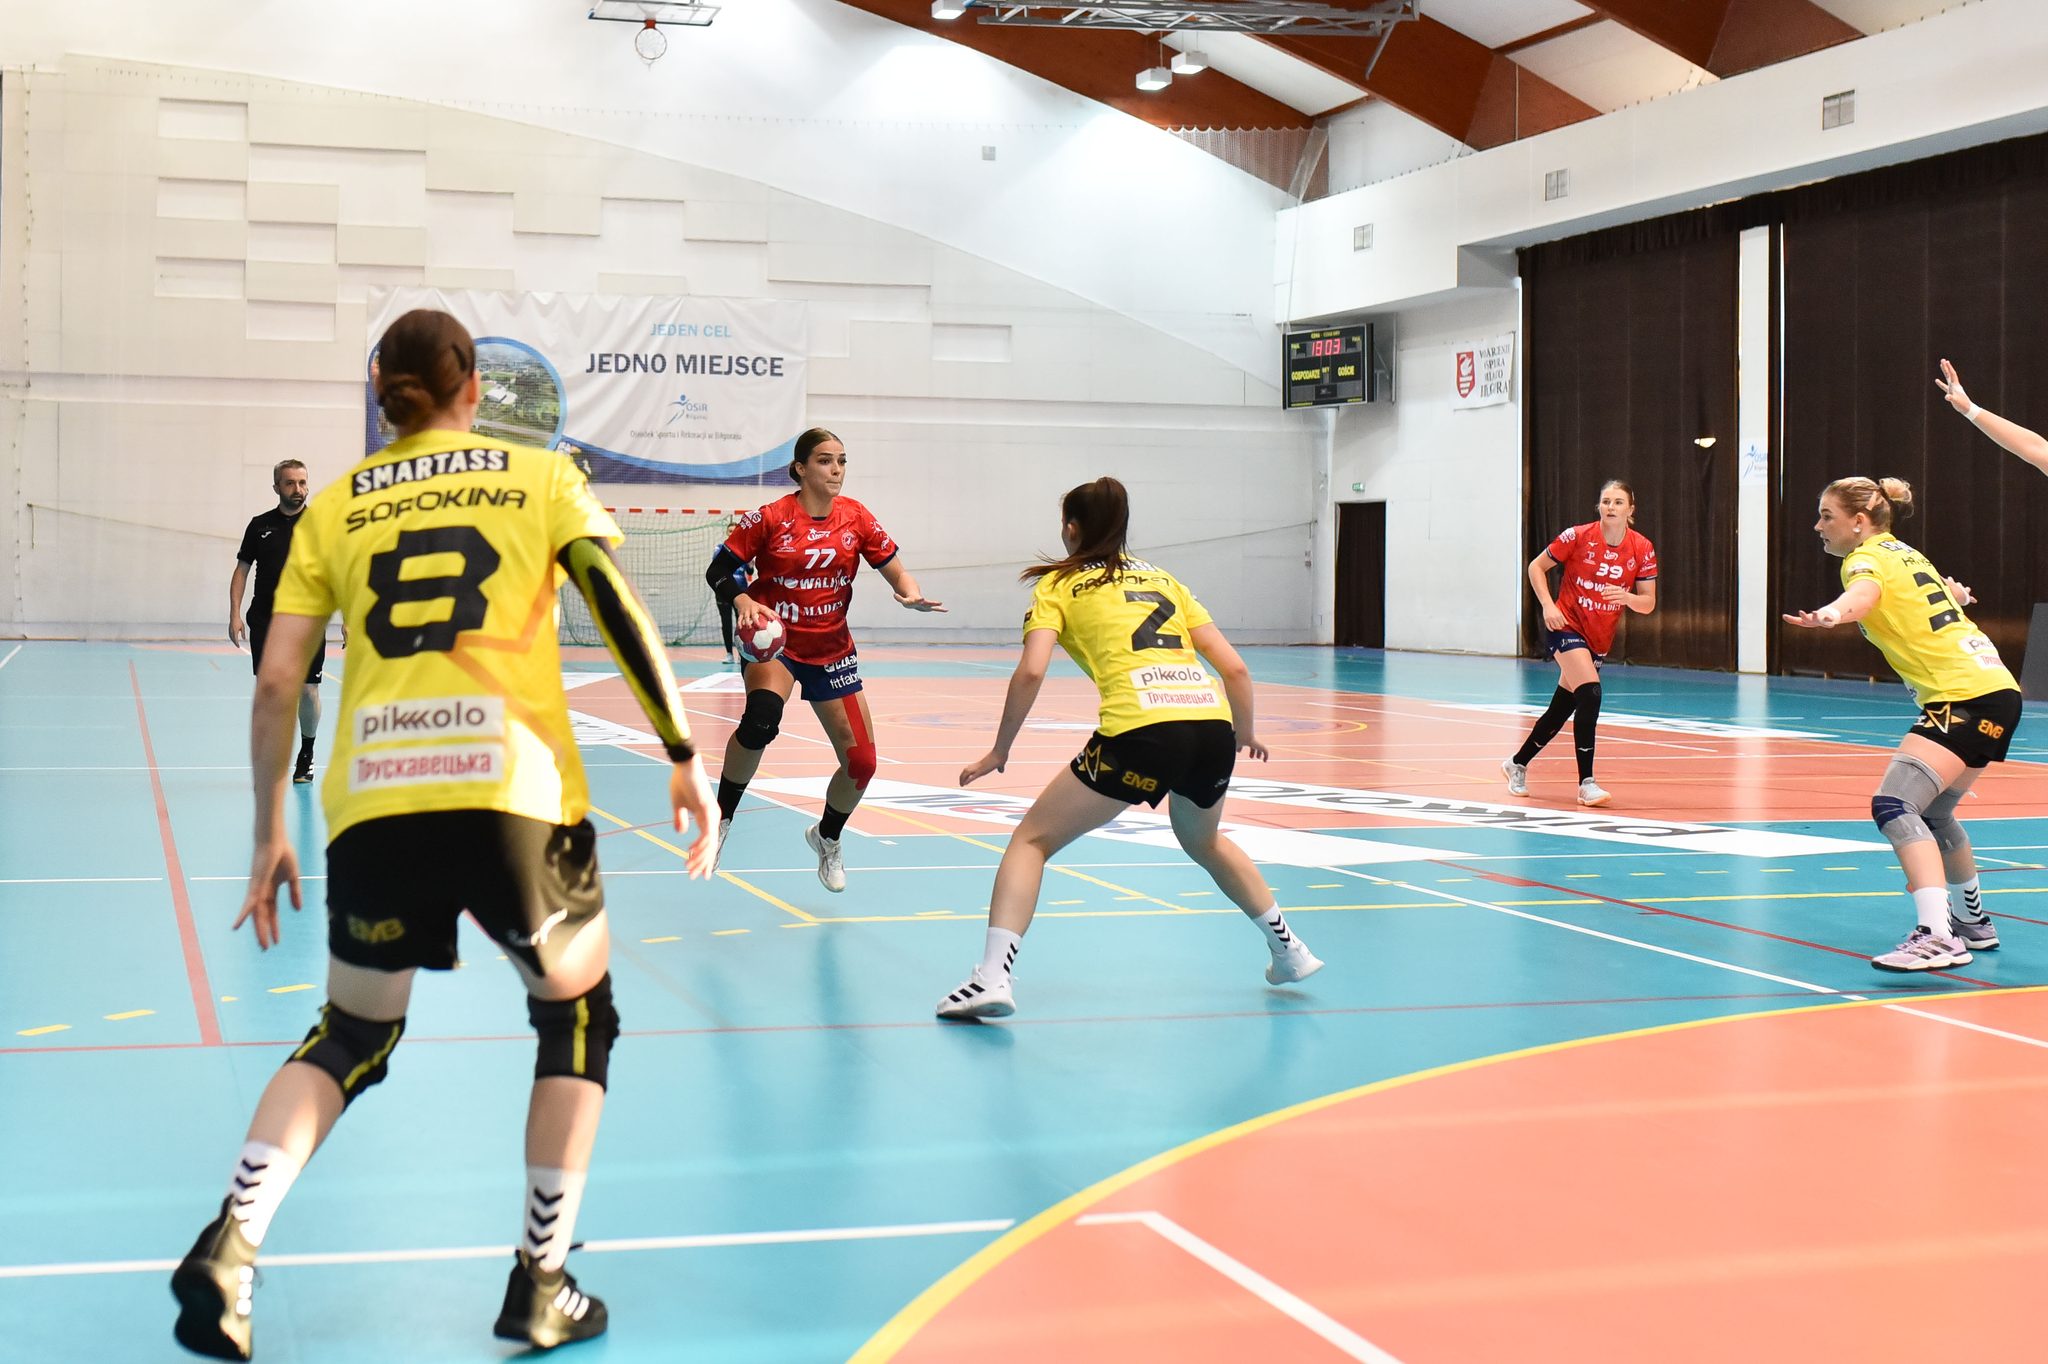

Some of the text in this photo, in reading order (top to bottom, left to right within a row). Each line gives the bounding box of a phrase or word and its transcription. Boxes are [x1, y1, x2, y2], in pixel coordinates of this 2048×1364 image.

[650, 322, 732, 338] JEDEN CEL
[585, 353, 785, 378] JEDNO MIEJSCE
[355, 448, 505, 494] SMARTASS
[804, 548, 837, 570] 77
[1595, 562, 1624, 580] 39
[364, 525, 501, 660] 8
[1123, 590, 1185, 652] 2
